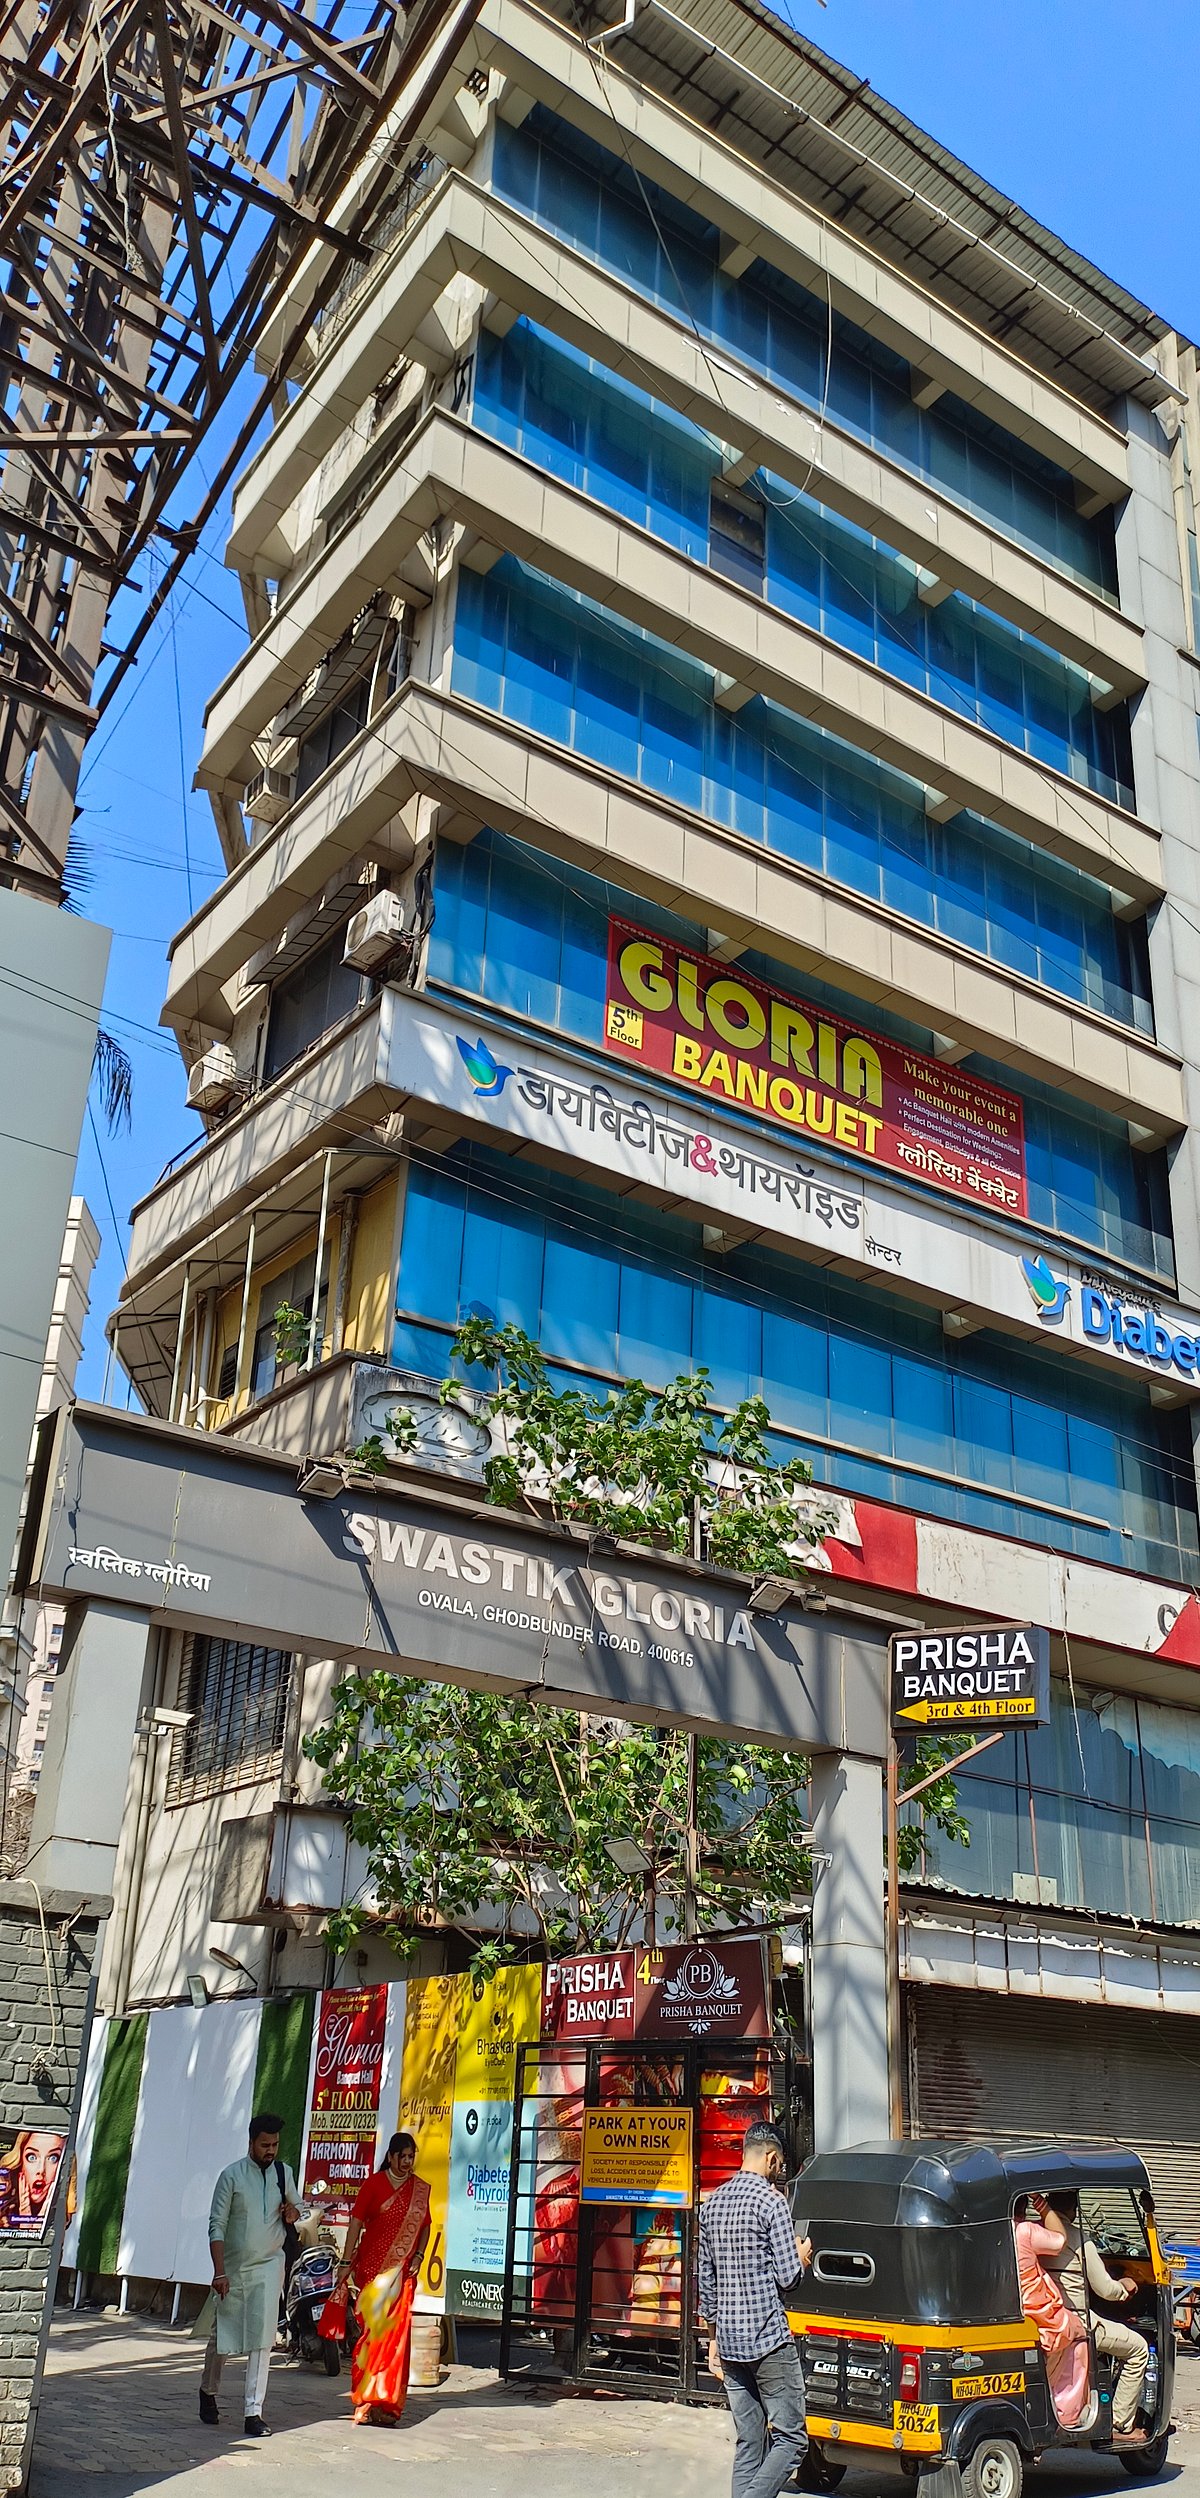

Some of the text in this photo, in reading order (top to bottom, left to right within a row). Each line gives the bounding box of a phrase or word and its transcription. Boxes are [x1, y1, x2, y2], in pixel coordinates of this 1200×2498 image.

[611, 1005, 641, 1029] 5th
[618, 941, 884, 1109] GLORIA
[609, 1026, 641, 1047] Floor
[672, 1033, 884, 1155] BANQUET
[903, 1059, 1017, 1123] Make your event a
[913, 1086, 1009, 1137] memorable one
[903, 1110, 926, 1126] Perfect
[926, 1120, 962, 1143] Destination
[962, 1135, 972, 1147] for
[912, 1101, 939, 1120] Banquet
[939, 1112, 953, 1126] Hall
[966, 1125, 991, 1143] modern
[990, 1136, 1021, 1156] Amenities
[67, 1544, 212, 1593] स्वस्तिक ग्लोरिया
[341, 1511, 756, 1652] SWASTIK GLORIA
[417, 1589, 695, 1668] OVALA, GHODBUNDER ROAD, 400615
[895, 1631, 1035, 1673] PRISHA
[903, 1668, 1026, 1698] BANQUET
[926, 1699, 1032, 1718] 3rd & 4th Floor
[636, 1947, 664, 1985] 4th
[688, 1963, 712, 1984] PB
[545, 1961, 626, 1997] PRISHA
[566, 1996, 634, 2023] BANQUET
[660, 2002, 743, 2018] PRISHA BANQUET
[317, 2014, 382, 2079] Gloria
[476, 2038, 516, 2057] Bhaskar
[361, 2069, 374, 2084] Hall
[316, 2087, 373, 2110] 5th FLOOR
[311, 2112, 377, 2130] Mob. 92222 02323
[588, 2116, 687, 2131] PARK AT YOUR
[309, 2142, 360, 2162] HARMONY
[603, 2133, 671, 2148] OWN RISK
[328, 2163, 370, 2179] BANQUETS
[467, 2164, 512, 2184] Diabete
[592, 2158, 678, 2167] SOCIETY NOT RESPONSIBLE FOR
[606, 2168, 637, 2176] ACCIDENTS
[344, 2183, 361, 2196] Pers
[587, 2176, 612, 2184] VEHICLES
[612, 2177, 635, 2185] PARKED
[980, 2372, 1023, 2395] 3034
[895, 2414, 937, 2434] 3034
